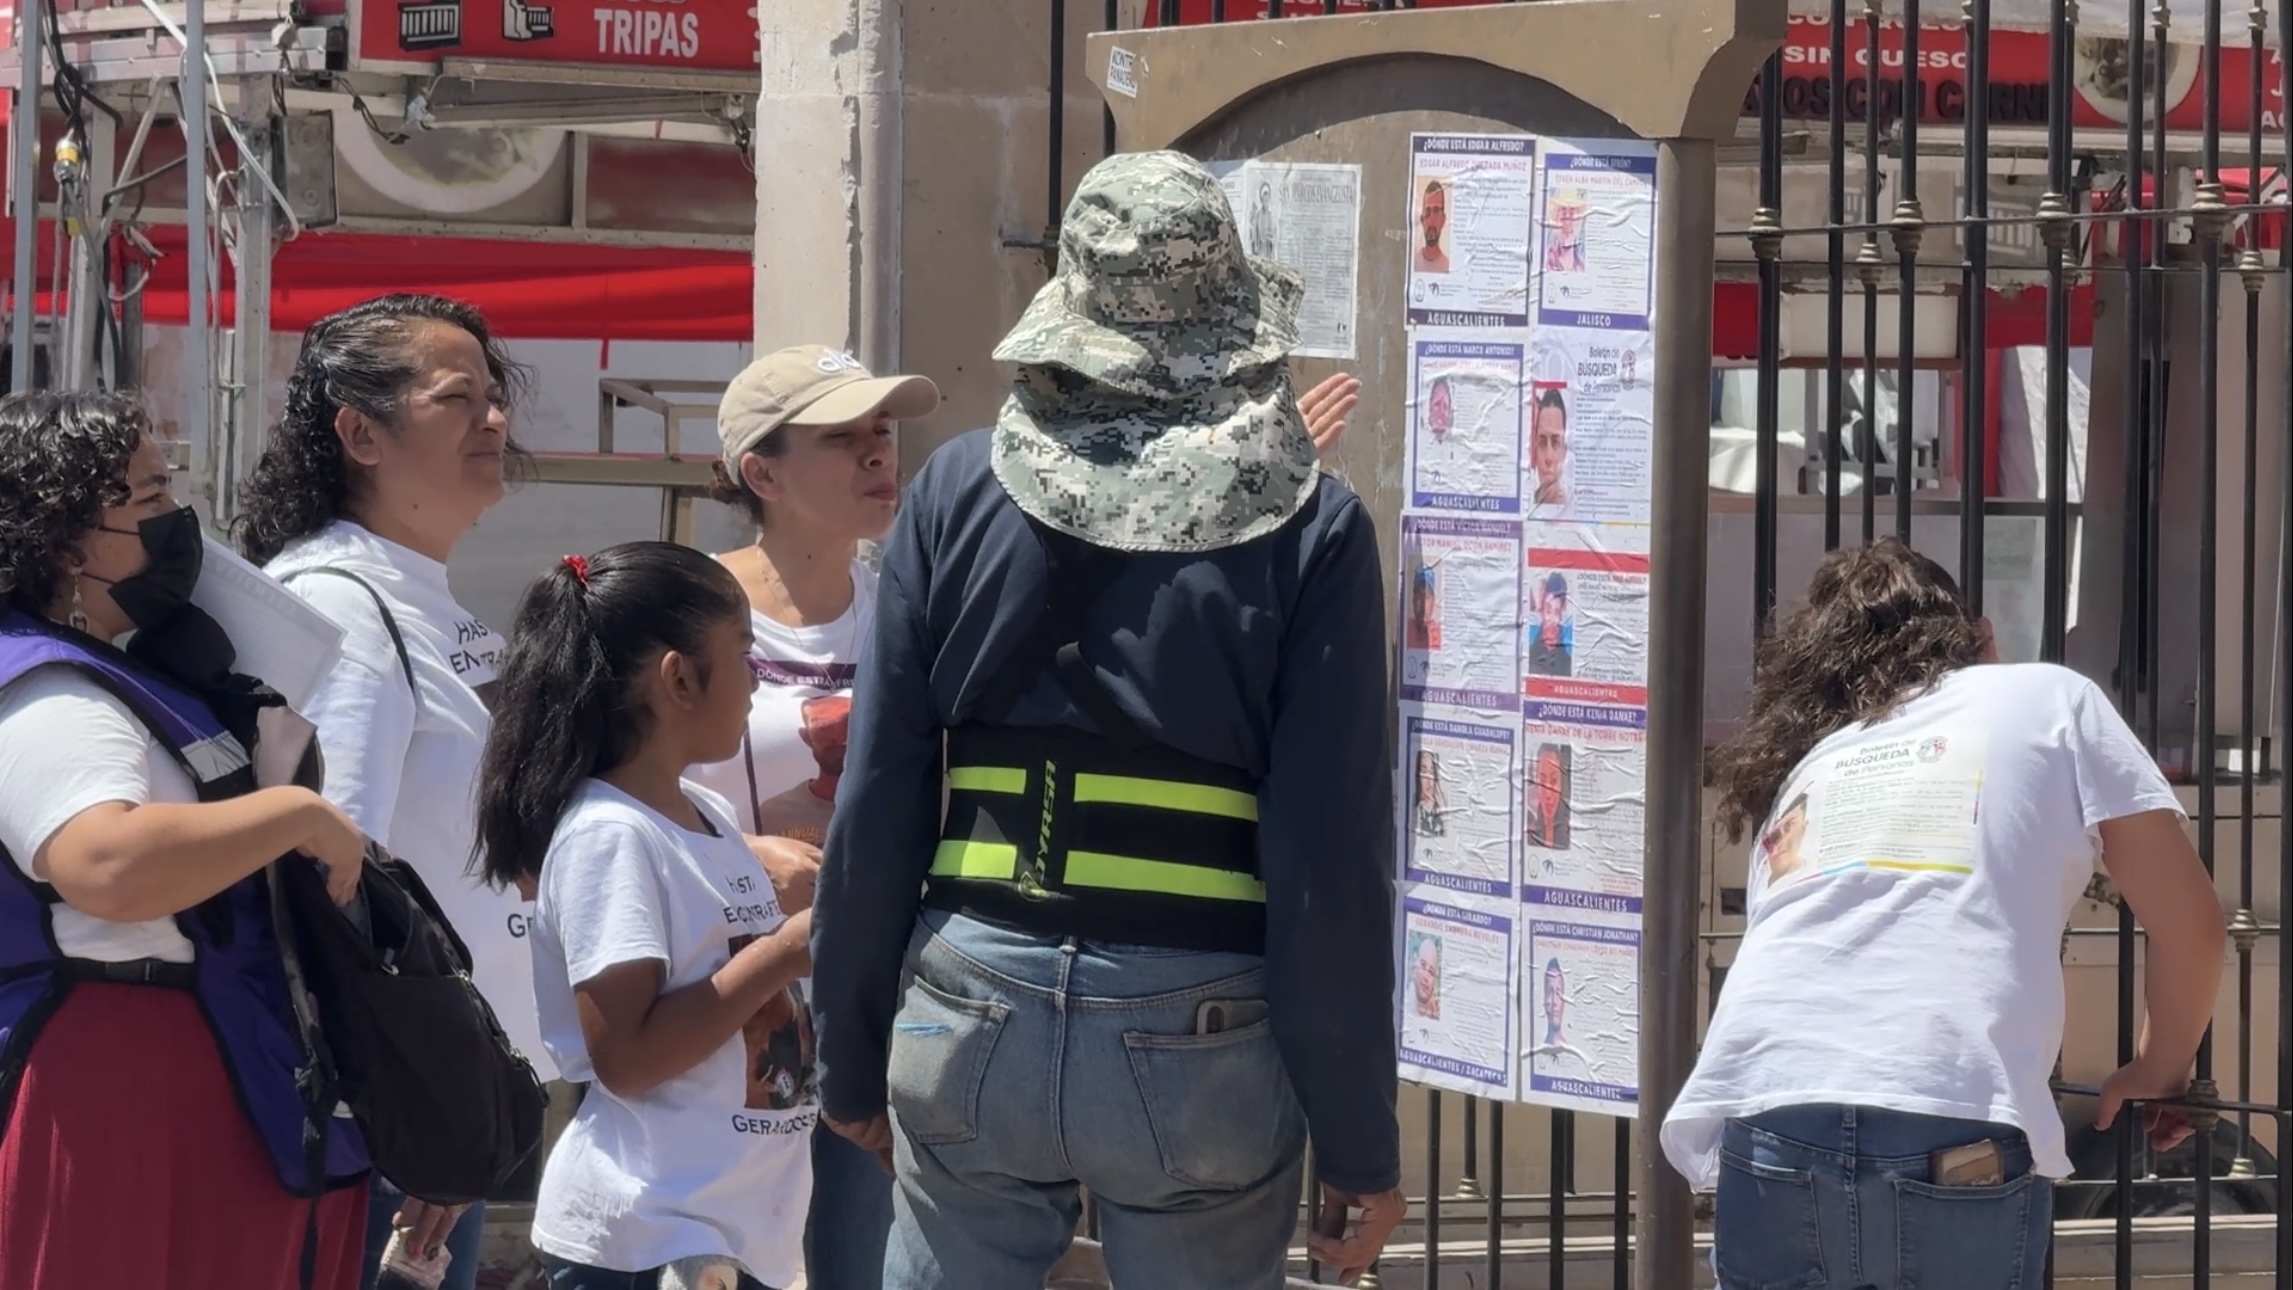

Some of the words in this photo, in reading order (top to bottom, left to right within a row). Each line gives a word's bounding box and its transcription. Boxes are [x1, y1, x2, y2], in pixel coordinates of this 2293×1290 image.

[594, 8, 699, 58] TRIPAS
[1468, 139, 1490, 150] EDGAR
[1491, 140, 1524, 152] ALFREDO?
[1427, 312, 1504, 327] AGUASCALIENTES
[1577, 314, 1611, 327] JALISCO
[1432, 496, 1499, 510] AGUASCALIENTES
[1423, 691, 1496, 706] AGUASCALIENTES
[1553, 685, 1618, 698] AGUASCALIENTES
[1538, 704, 1566, 718] ¿DÓNDE
[1586, 708, 1607, 720] KENIA
[1424, 874, 1492, 893] AGUASCALIENTES
[1544, 890, 1628, 912] AGUASCALIENTES
